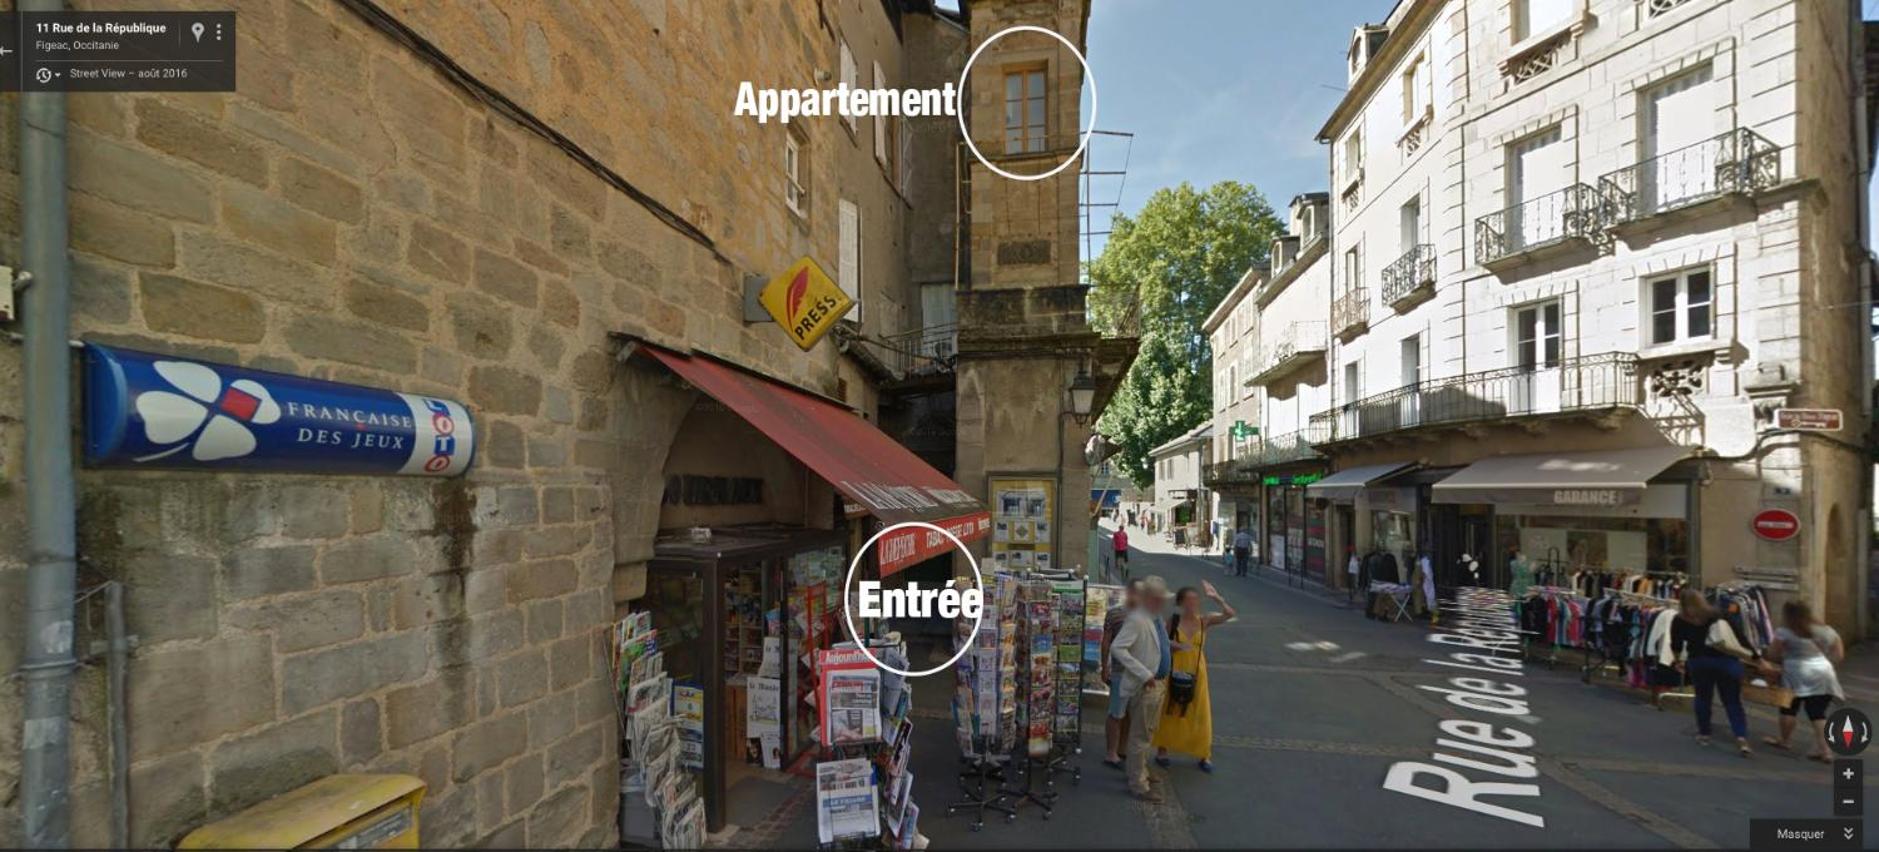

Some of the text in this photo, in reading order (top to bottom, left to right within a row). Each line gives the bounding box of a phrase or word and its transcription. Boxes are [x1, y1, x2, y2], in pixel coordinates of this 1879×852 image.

[794, 295, 837, 341] PRESS
[297, 428, 405, 449] DES JEUX
[423, 398, 456, 473] LOTO
[1554, 489, 1617, 504] GARANCE
